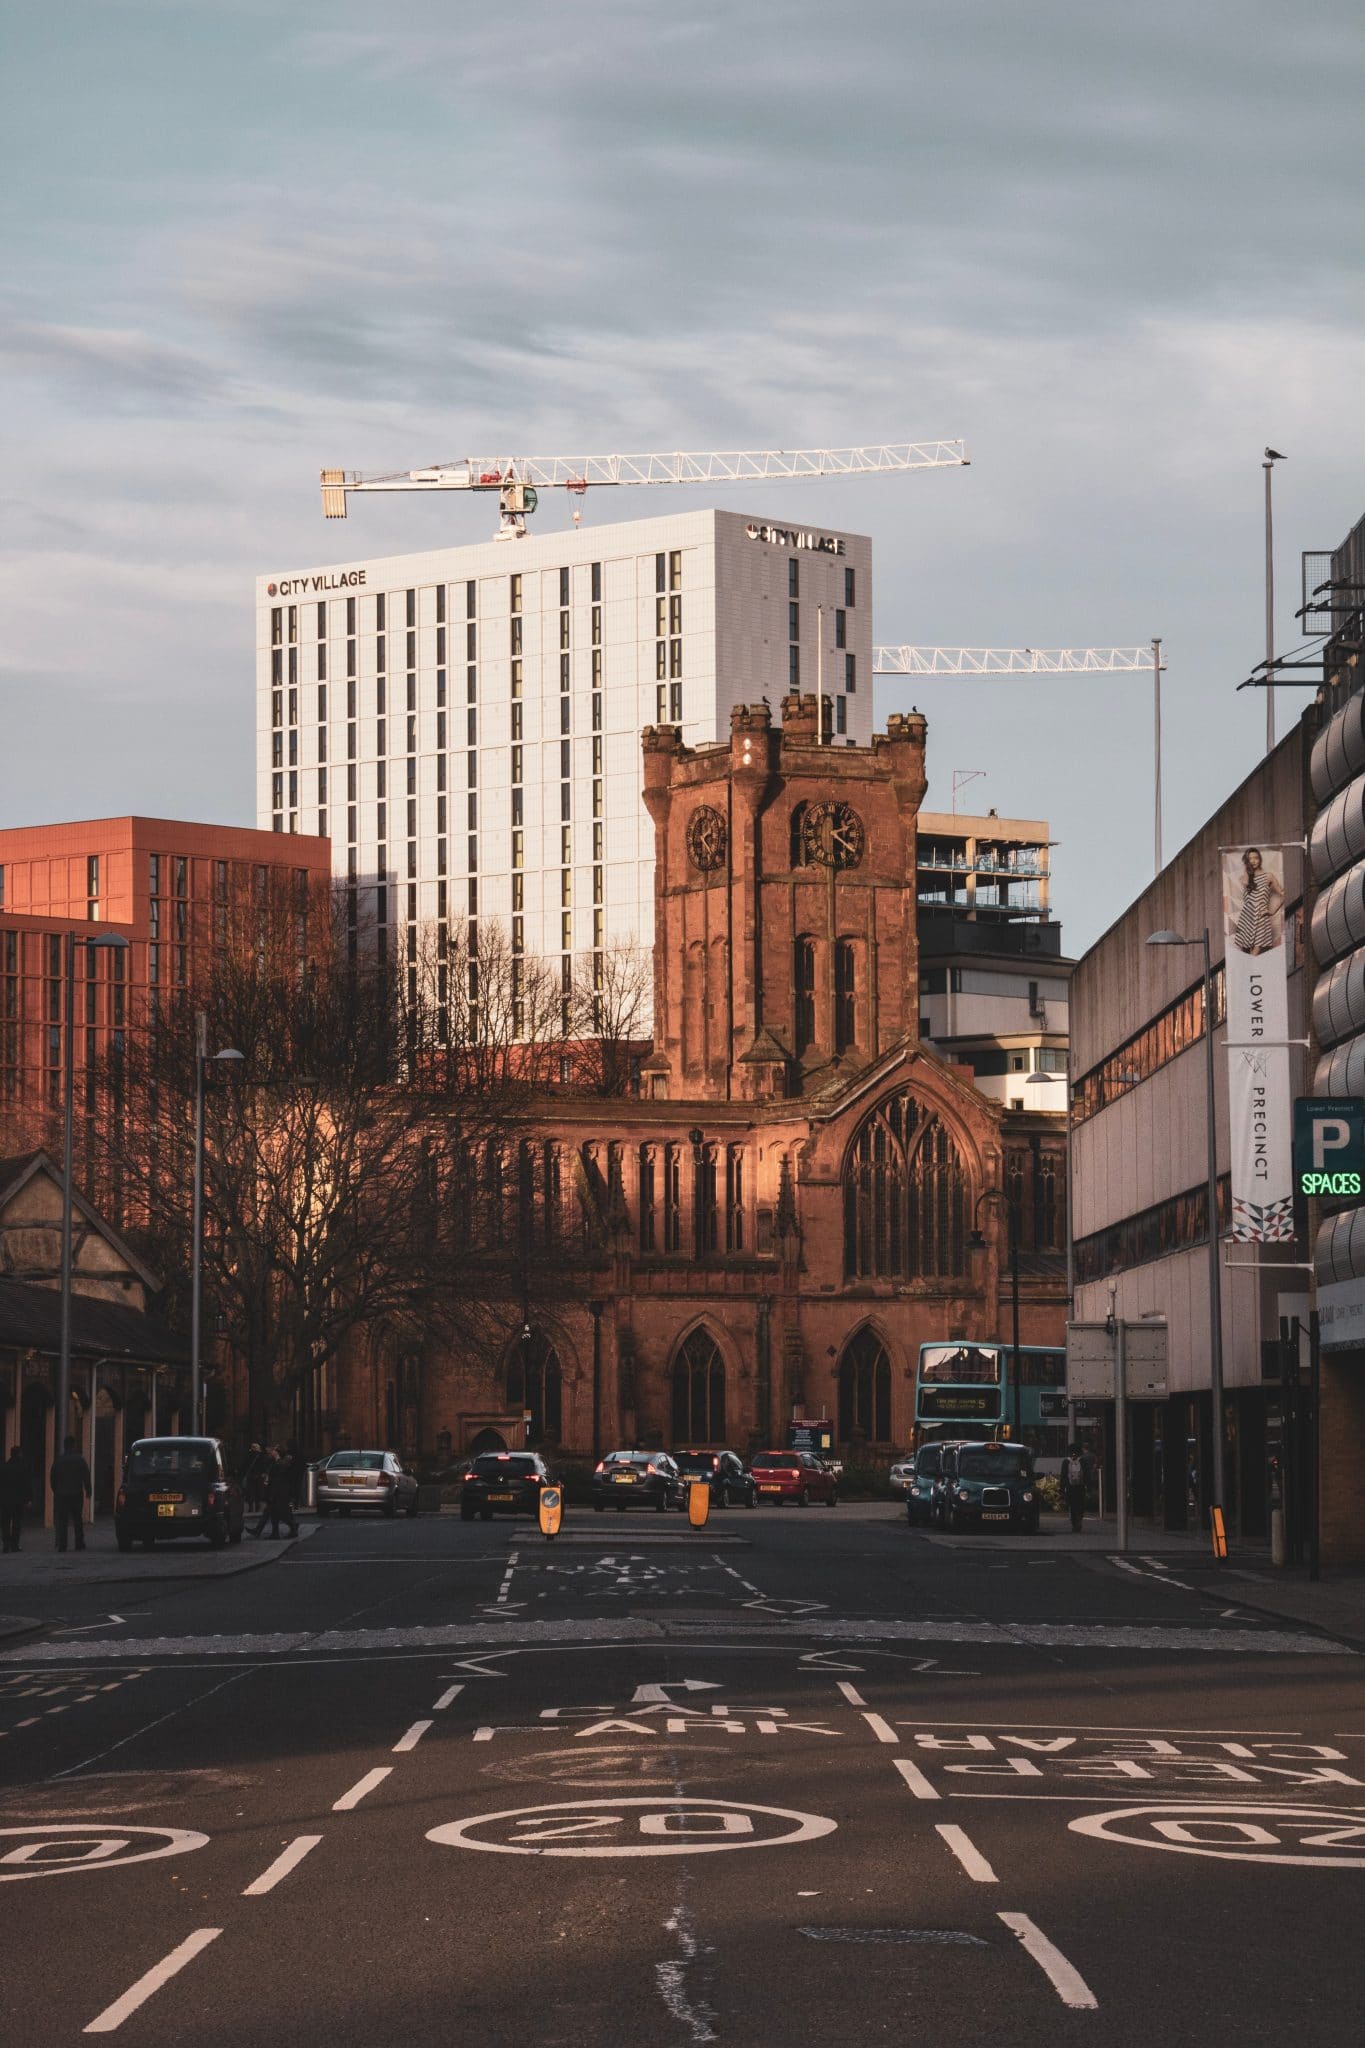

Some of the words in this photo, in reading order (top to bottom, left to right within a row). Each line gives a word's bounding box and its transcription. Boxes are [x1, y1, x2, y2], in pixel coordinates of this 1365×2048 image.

[760, 526, 789, 545] CITY
[790, 532, 846, 556] VILLAGE
[279, 578, 309, 596] CITY
[312, 570, 366, 591] VILLAGE
[1248, 973, 1264, 1039] LOWER
[1252, 1086, 1268, 1181] PRECINCT
[1312, 1118, 1351, 1168] P
[1301, 1172, 1361, 1195] SPACES
[538, 1703, 789, 1718] CAR
[914, 1734, 1349, 1760] CLEAR
[943, 1757, 1365, 1786] KEEP
[508, 1811, 754, 1842] 20
